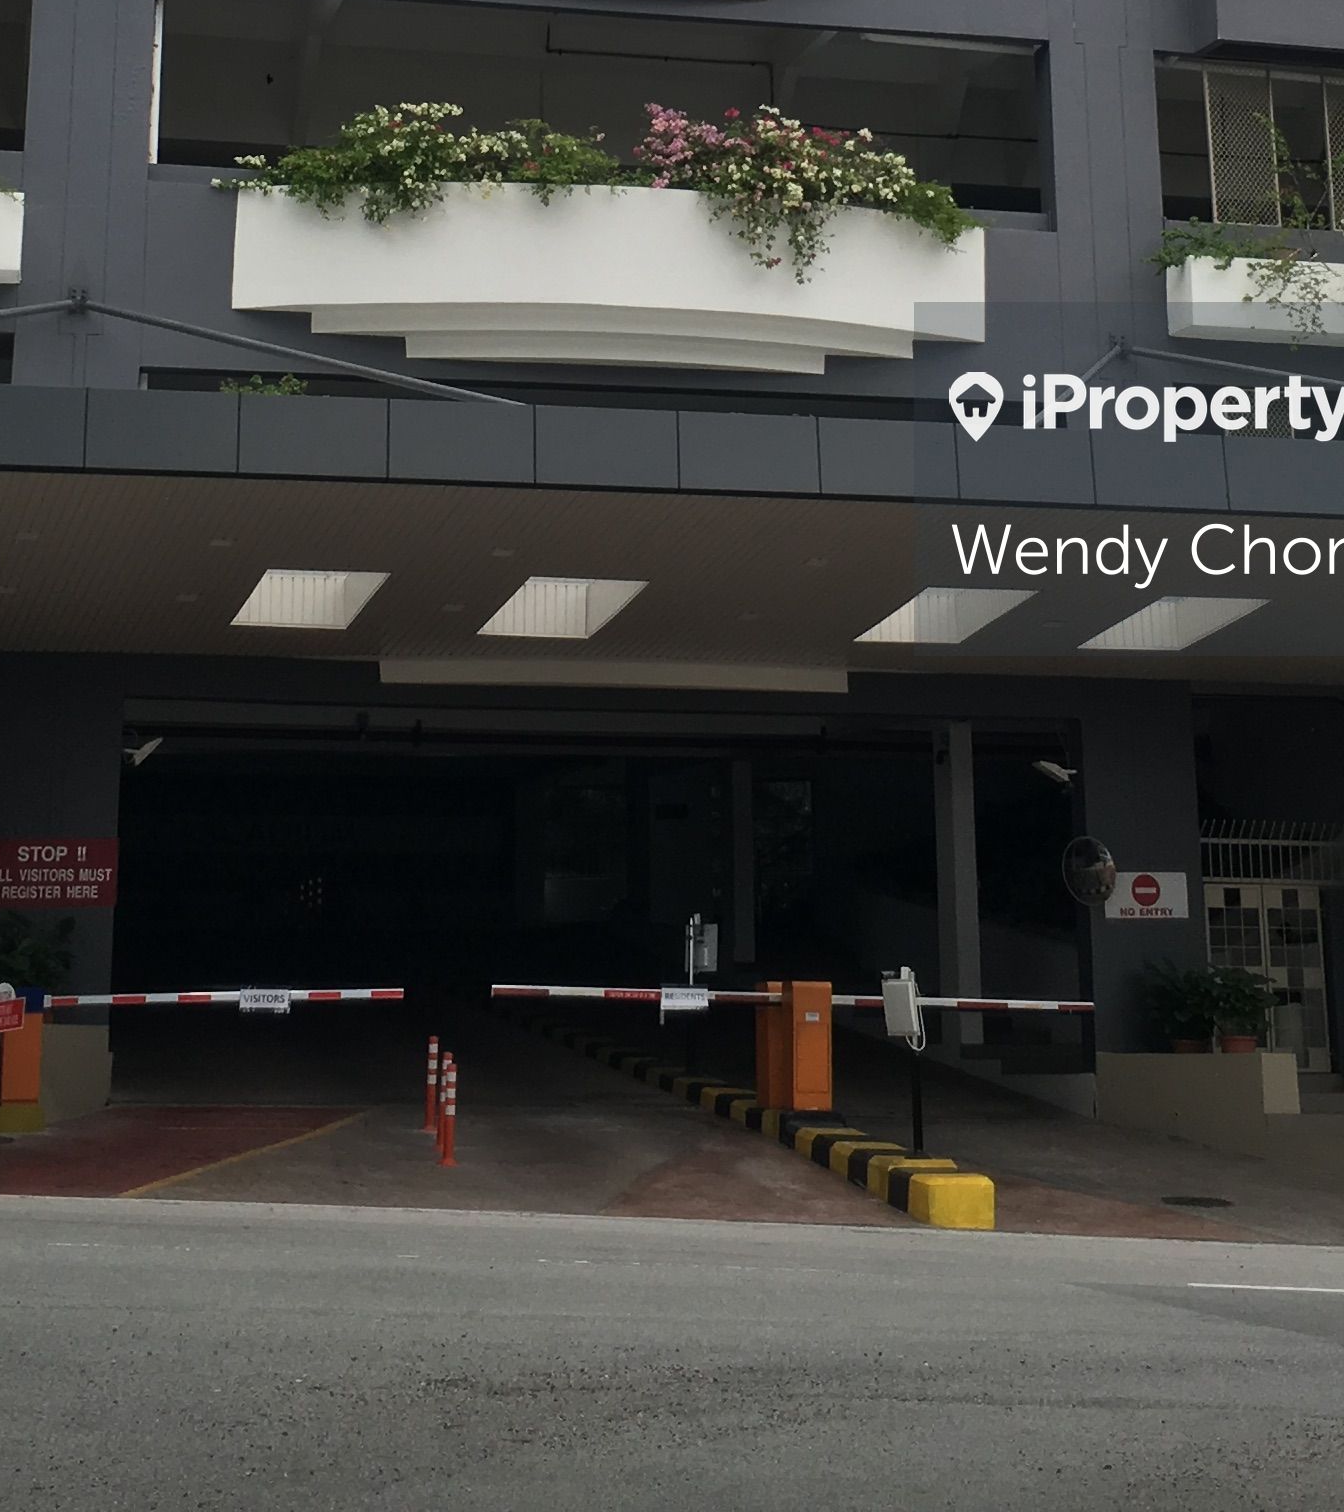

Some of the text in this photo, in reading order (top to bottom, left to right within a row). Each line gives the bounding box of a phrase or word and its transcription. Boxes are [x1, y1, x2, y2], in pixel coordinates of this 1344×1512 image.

[17, 846, 68, 862] STOP
[19, 868, 74, 881] VISITORS
[78, 868, 112, 881] MUST
[1, 886, 98, 899] REGISTER HERE
[1119, 907, 1173, 917] NO ENTRY
[243, 994, 286, 1003] VISITORS
